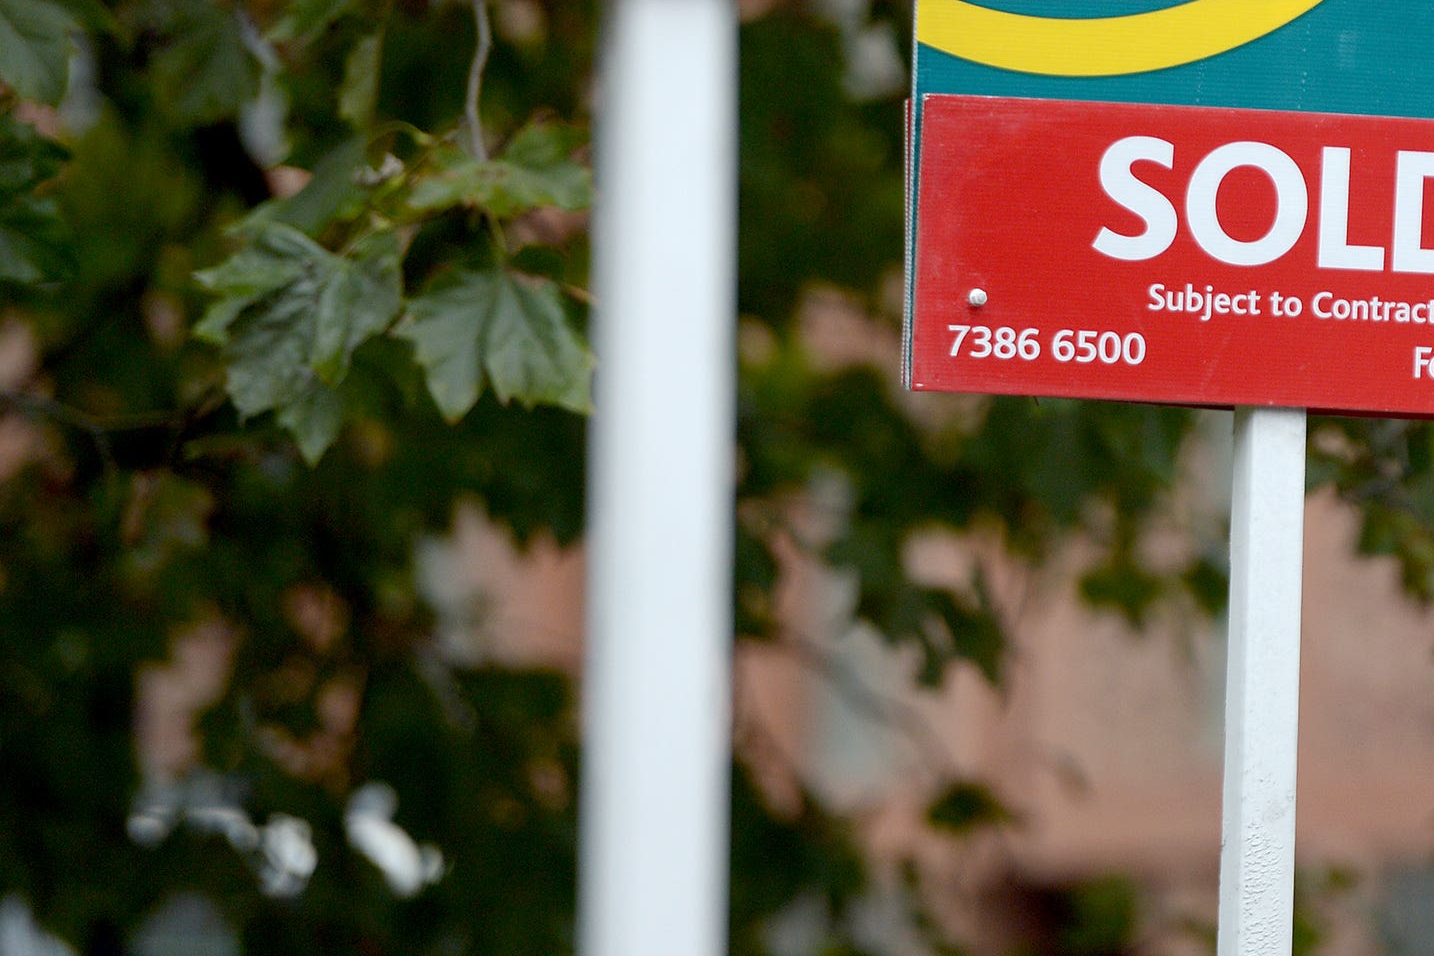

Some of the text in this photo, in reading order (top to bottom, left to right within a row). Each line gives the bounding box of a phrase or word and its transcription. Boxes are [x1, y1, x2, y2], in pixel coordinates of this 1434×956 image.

[1147, 283, 1262, 322] Subject
[1269, 290, 1303, 319] to
[947, 324, 1147, 366] 7386 6500
